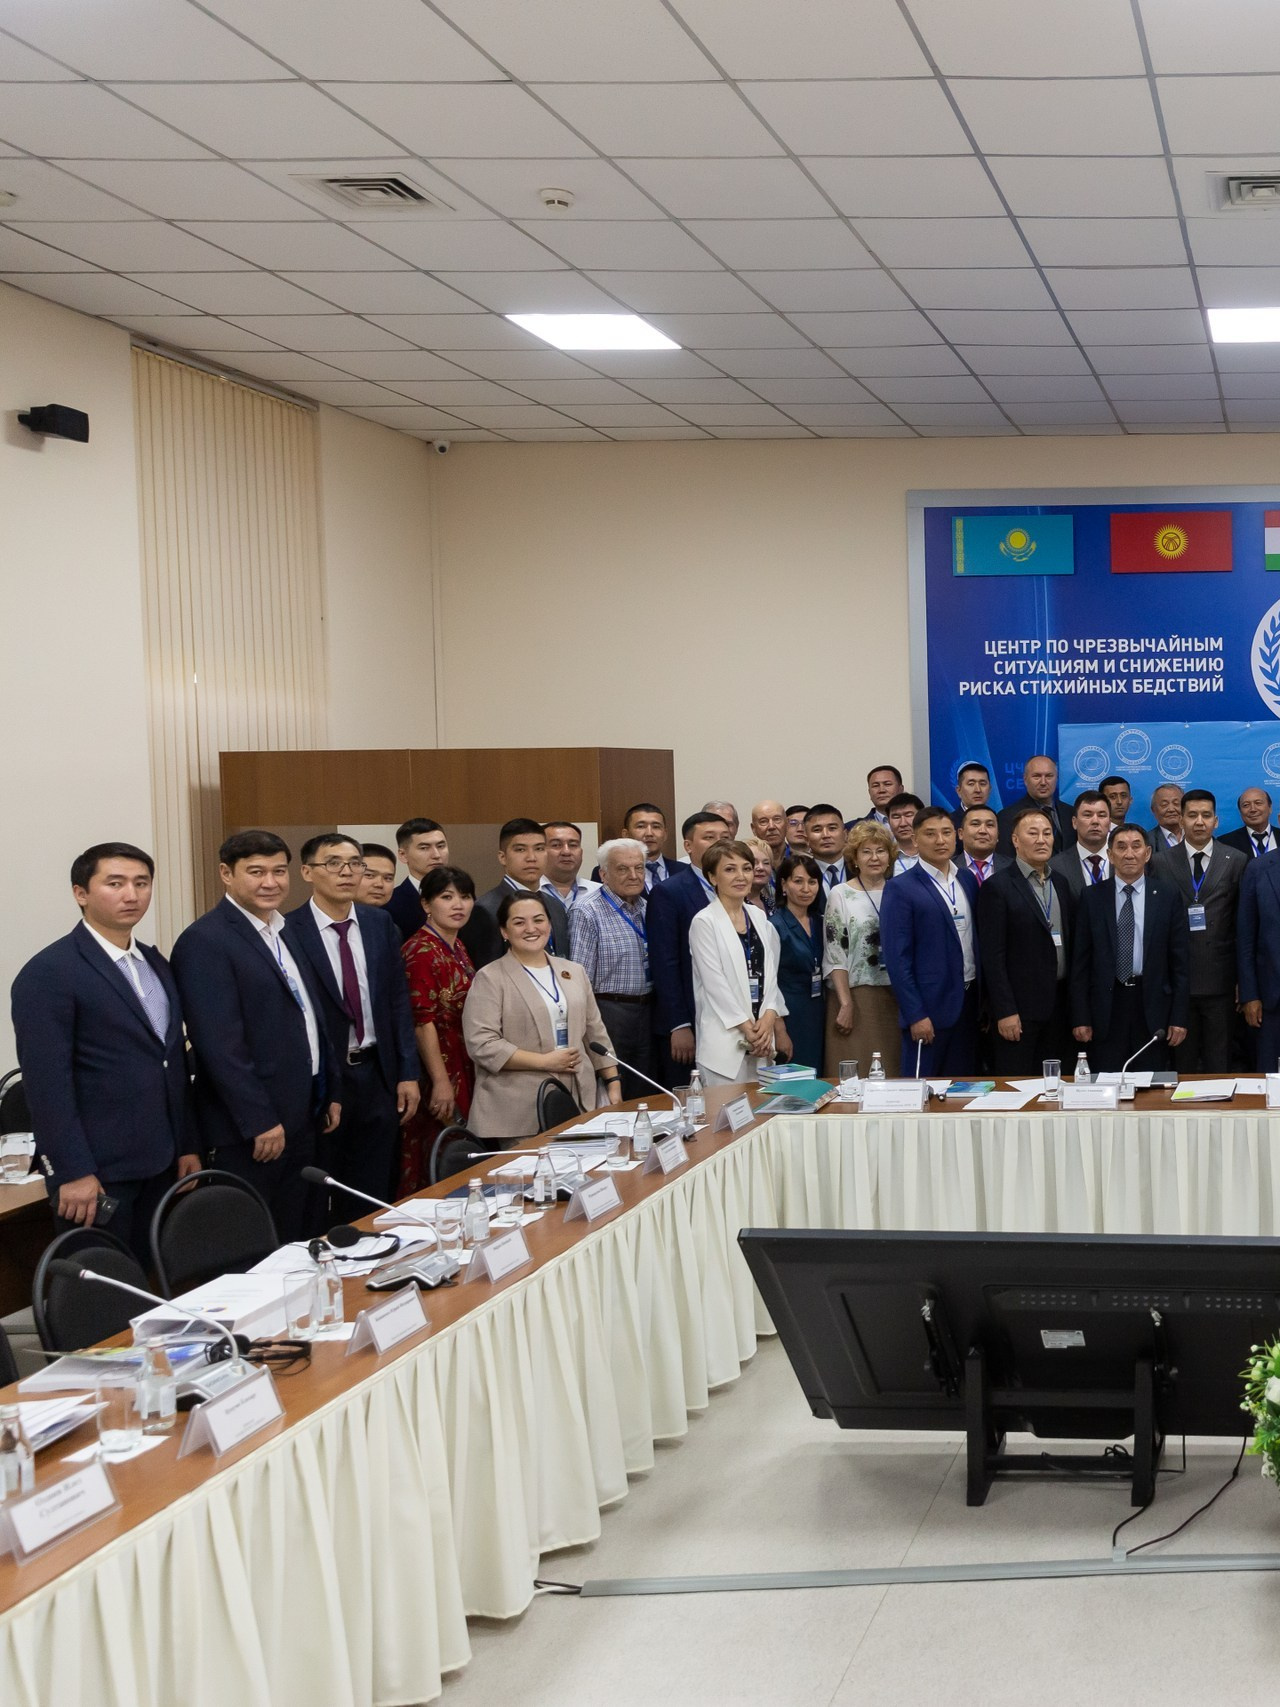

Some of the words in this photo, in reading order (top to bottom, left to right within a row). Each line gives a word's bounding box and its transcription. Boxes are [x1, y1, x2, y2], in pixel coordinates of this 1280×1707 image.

[984, 639, 1042, 658] ЦЕНТР
[1046, 639, 1069, 654] ПО
[1073, 634, 1223, 654] ЧРЕЗВЫЧАЙНЫМ
[993, 659, 1099, 677] СИТУАЦИЯМ
[1103, 658, 1116, 674] И
[1119, 657, 1224, 674] СНИЖЕНИЮ
[959, 680, 1017, 696] РИСКА
[1019, 676, 1128, 695] СТИХИЙНЫХ
[1132, 674, 1224, 696] БЕДСТВИЙ
